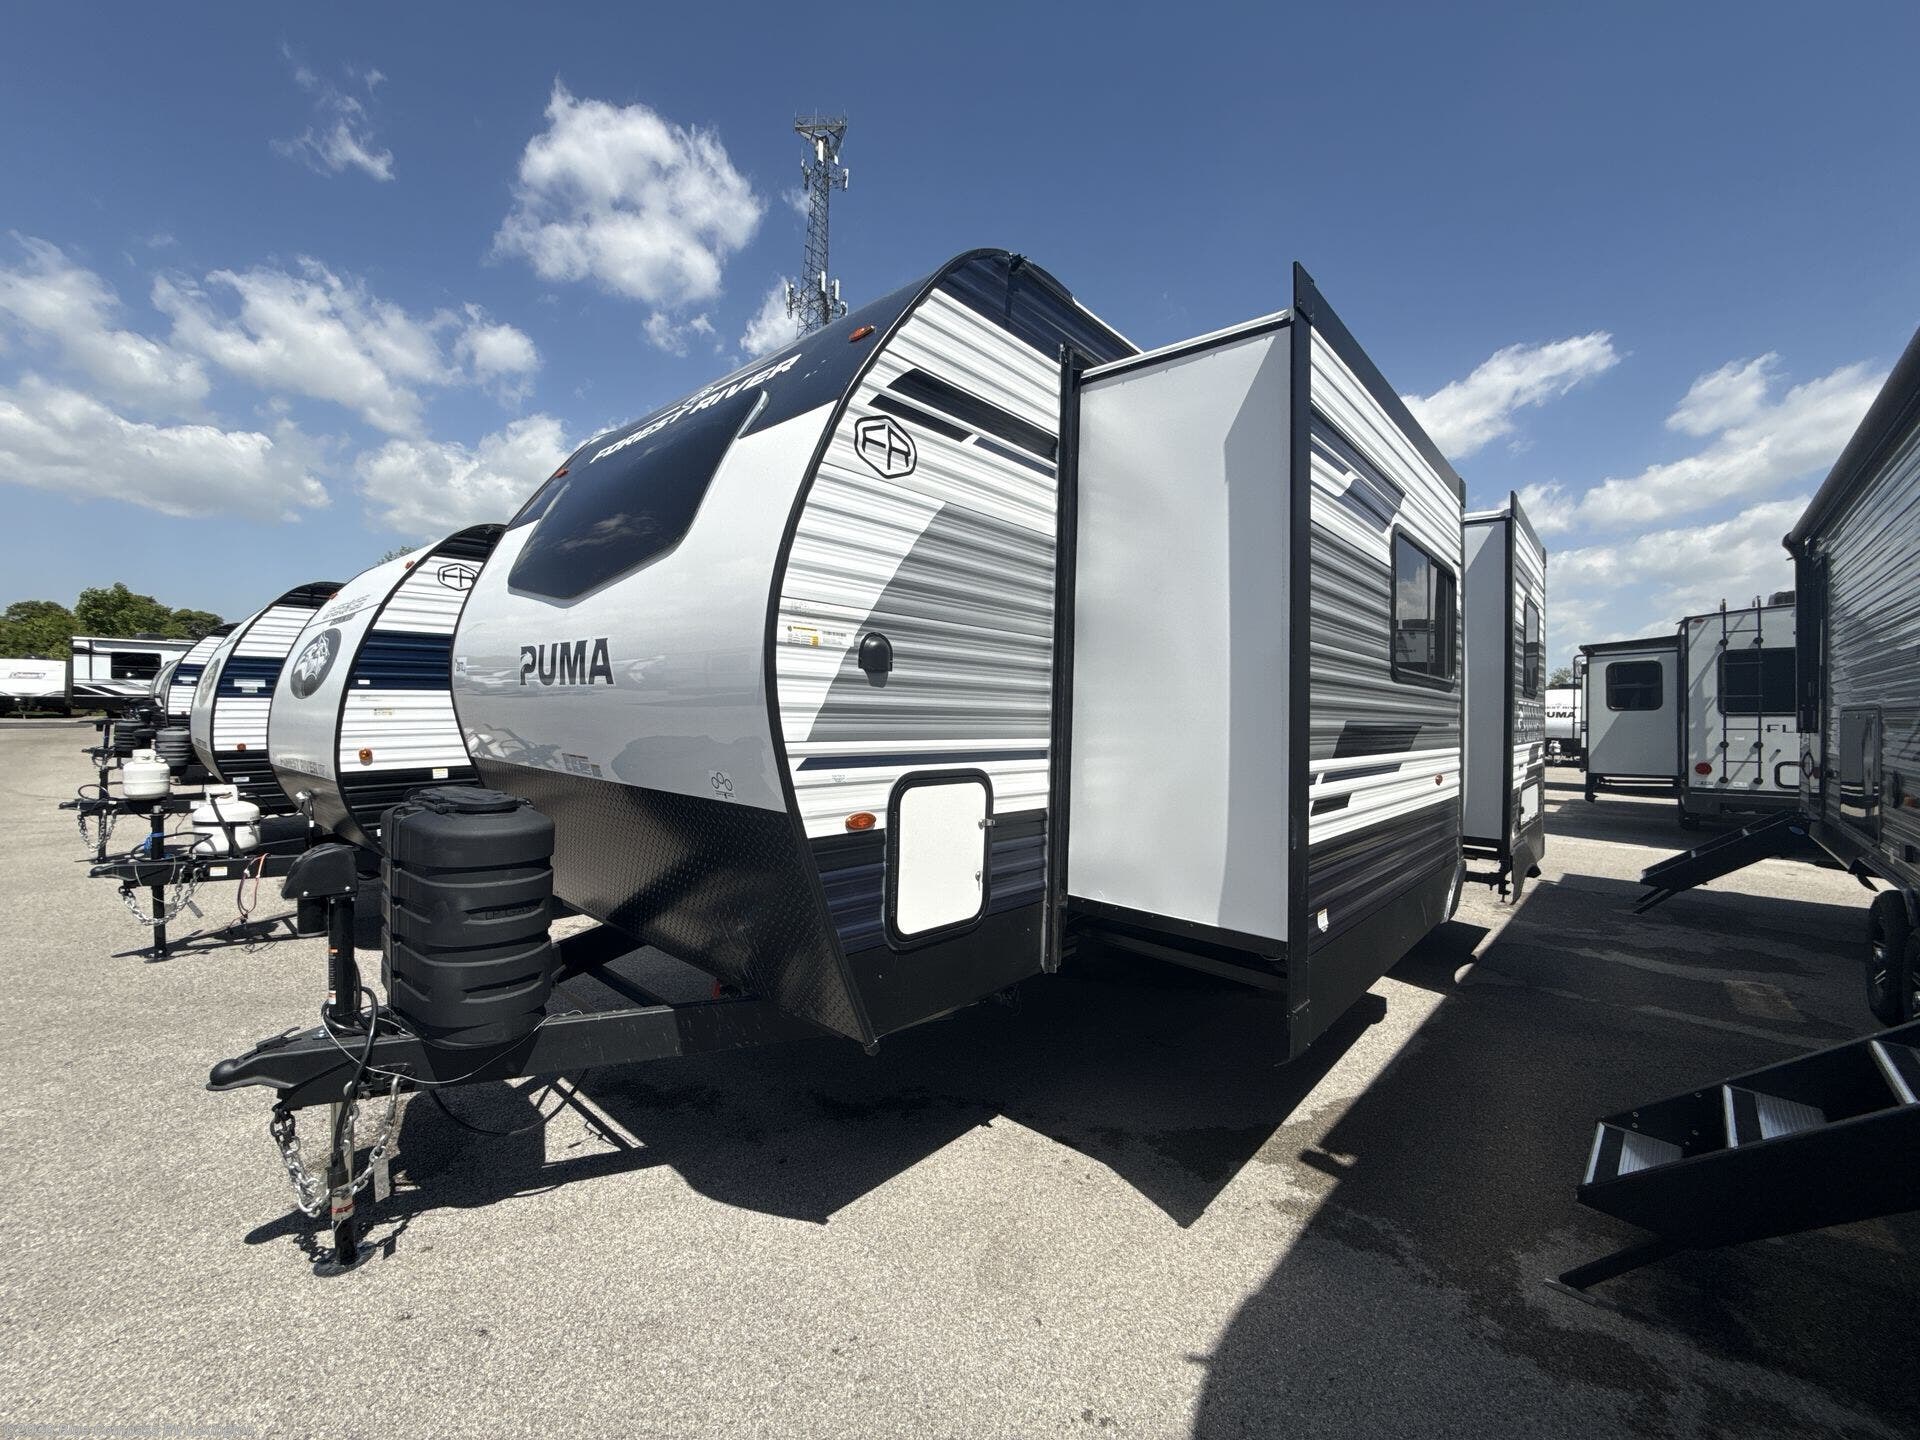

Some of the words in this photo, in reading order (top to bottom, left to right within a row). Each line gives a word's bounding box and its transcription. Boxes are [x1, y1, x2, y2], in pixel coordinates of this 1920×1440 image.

[588, 407, 693, 464] FOREST
[689, 353, 802, 415] RIVER
[519, 637, 615, 687] PUMA
[1545, 711, 1577, 719] UMA
